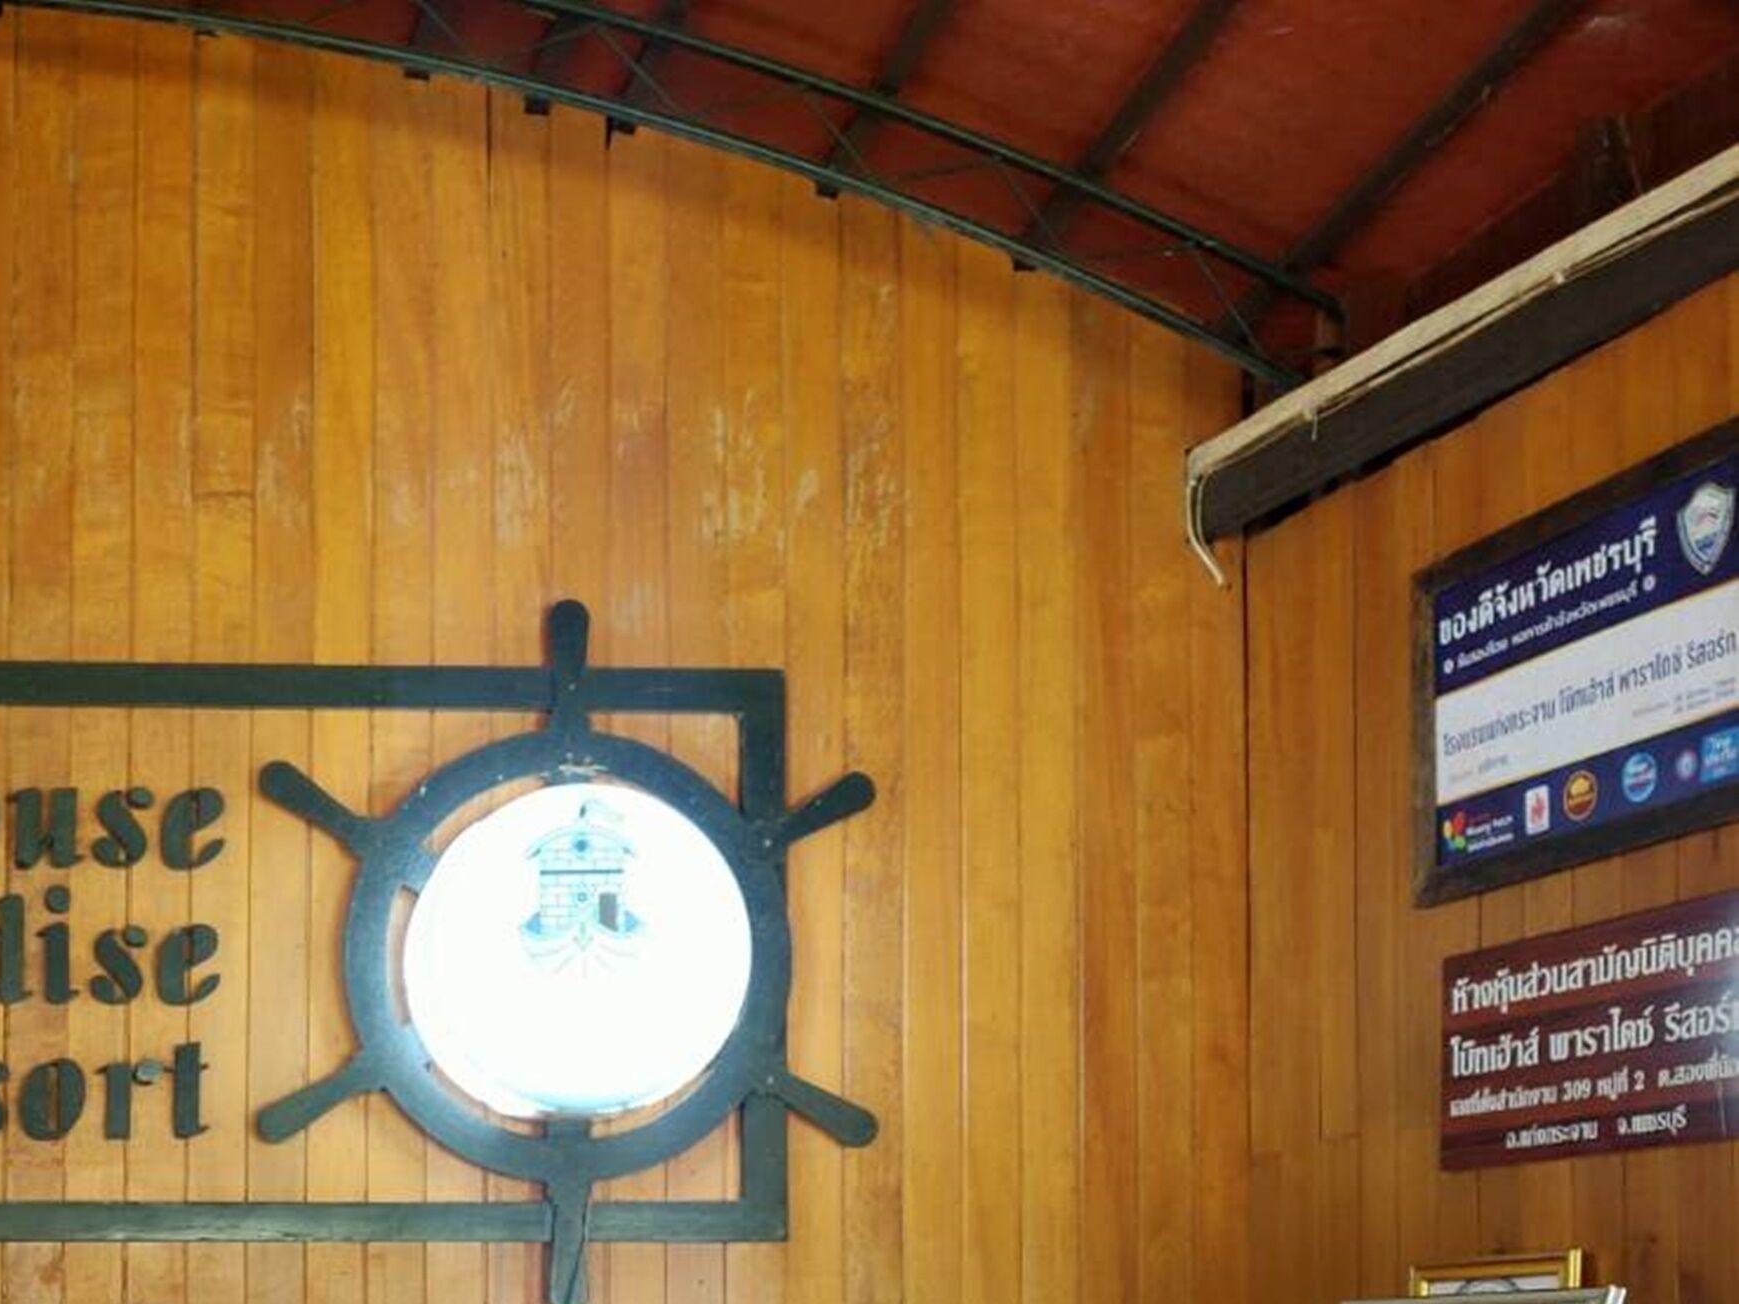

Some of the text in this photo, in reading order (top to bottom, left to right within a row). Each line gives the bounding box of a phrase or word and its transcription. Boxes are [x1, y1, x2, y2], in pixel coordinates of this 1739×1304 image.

[1439, 515, 1657, 646] ของดีจังหวัดเพชรบุรี
[1451, 926, 1739, 1016] ห้างหุ้นส่วนสามัญนิติบุคค
[1548, 1005, 1655, 1061] พาราไดซ์
[1563, 1079, 1592, 1101] 309
[1633, 1070, 1645, 1091] 2
